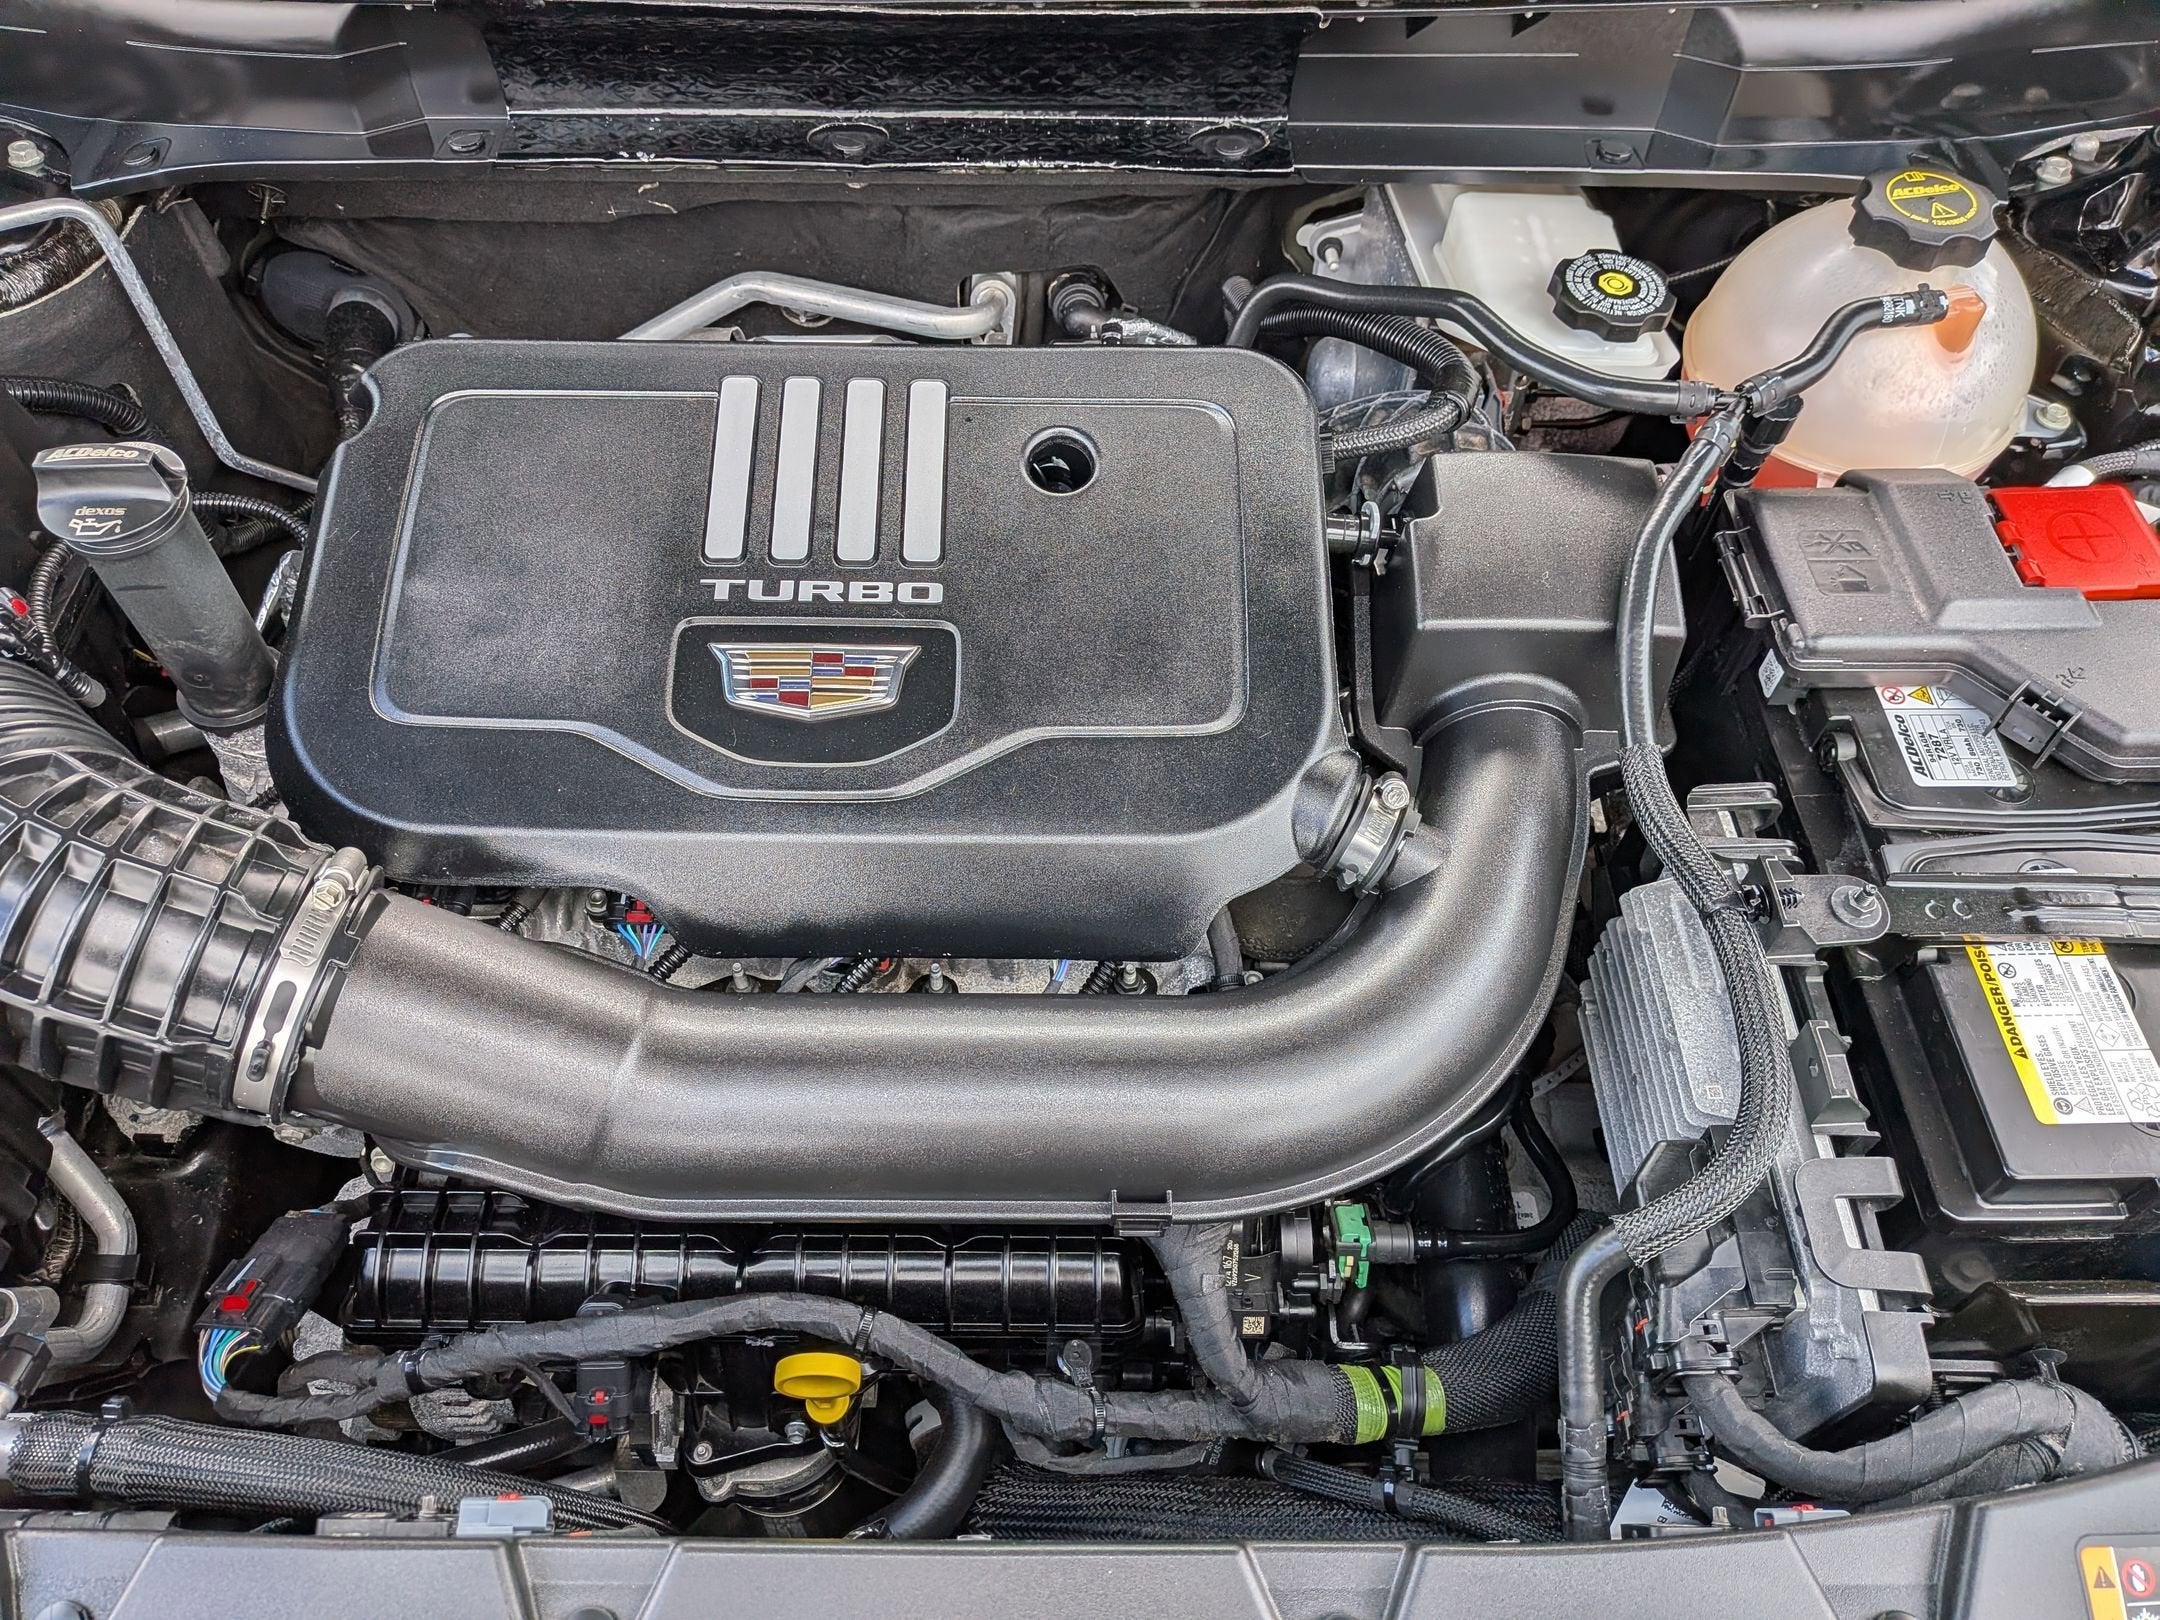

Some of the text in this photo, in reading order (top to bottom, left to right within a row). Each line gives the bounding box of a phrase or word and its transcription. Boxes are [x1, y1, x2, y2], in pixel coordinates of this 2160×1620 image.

[1892, 184, 1961, 197] ACDelco
[46, 447, 140, 460] ACDelco
[74, 506, 127, 516] dexos
[700, 579, 943, 603] TURBO
[1954, 718, 1965, 732] 730
[1894, 714, 1928, 777] ACDelco
[1917, 731, 1936, 762] 94RAGM
[1927, 734, 1948, 760] 7287
[1938, 728, 1961, 765] 12V VRLA
[1973, 761, 1984, 775] 730
[1982, 758, 1997, 780] GENERAL
[1977, 944, 2023, 1047] DANGER/POIS
[2035, 1035, 2068, 1095] EXPLOSIVE GASES
[2056, 1060, 2072, 1081] CAUSE
[2077, 1065, 2090, 1078] LES
[2079, 1049, 2102, 1085] EXPLOSIFS
[2042, 1071, 2060, 1095] SHIELD
[2096, 1087, 2109, 1100] GAZ
[2102, 1102, 2115, 1115] LES
